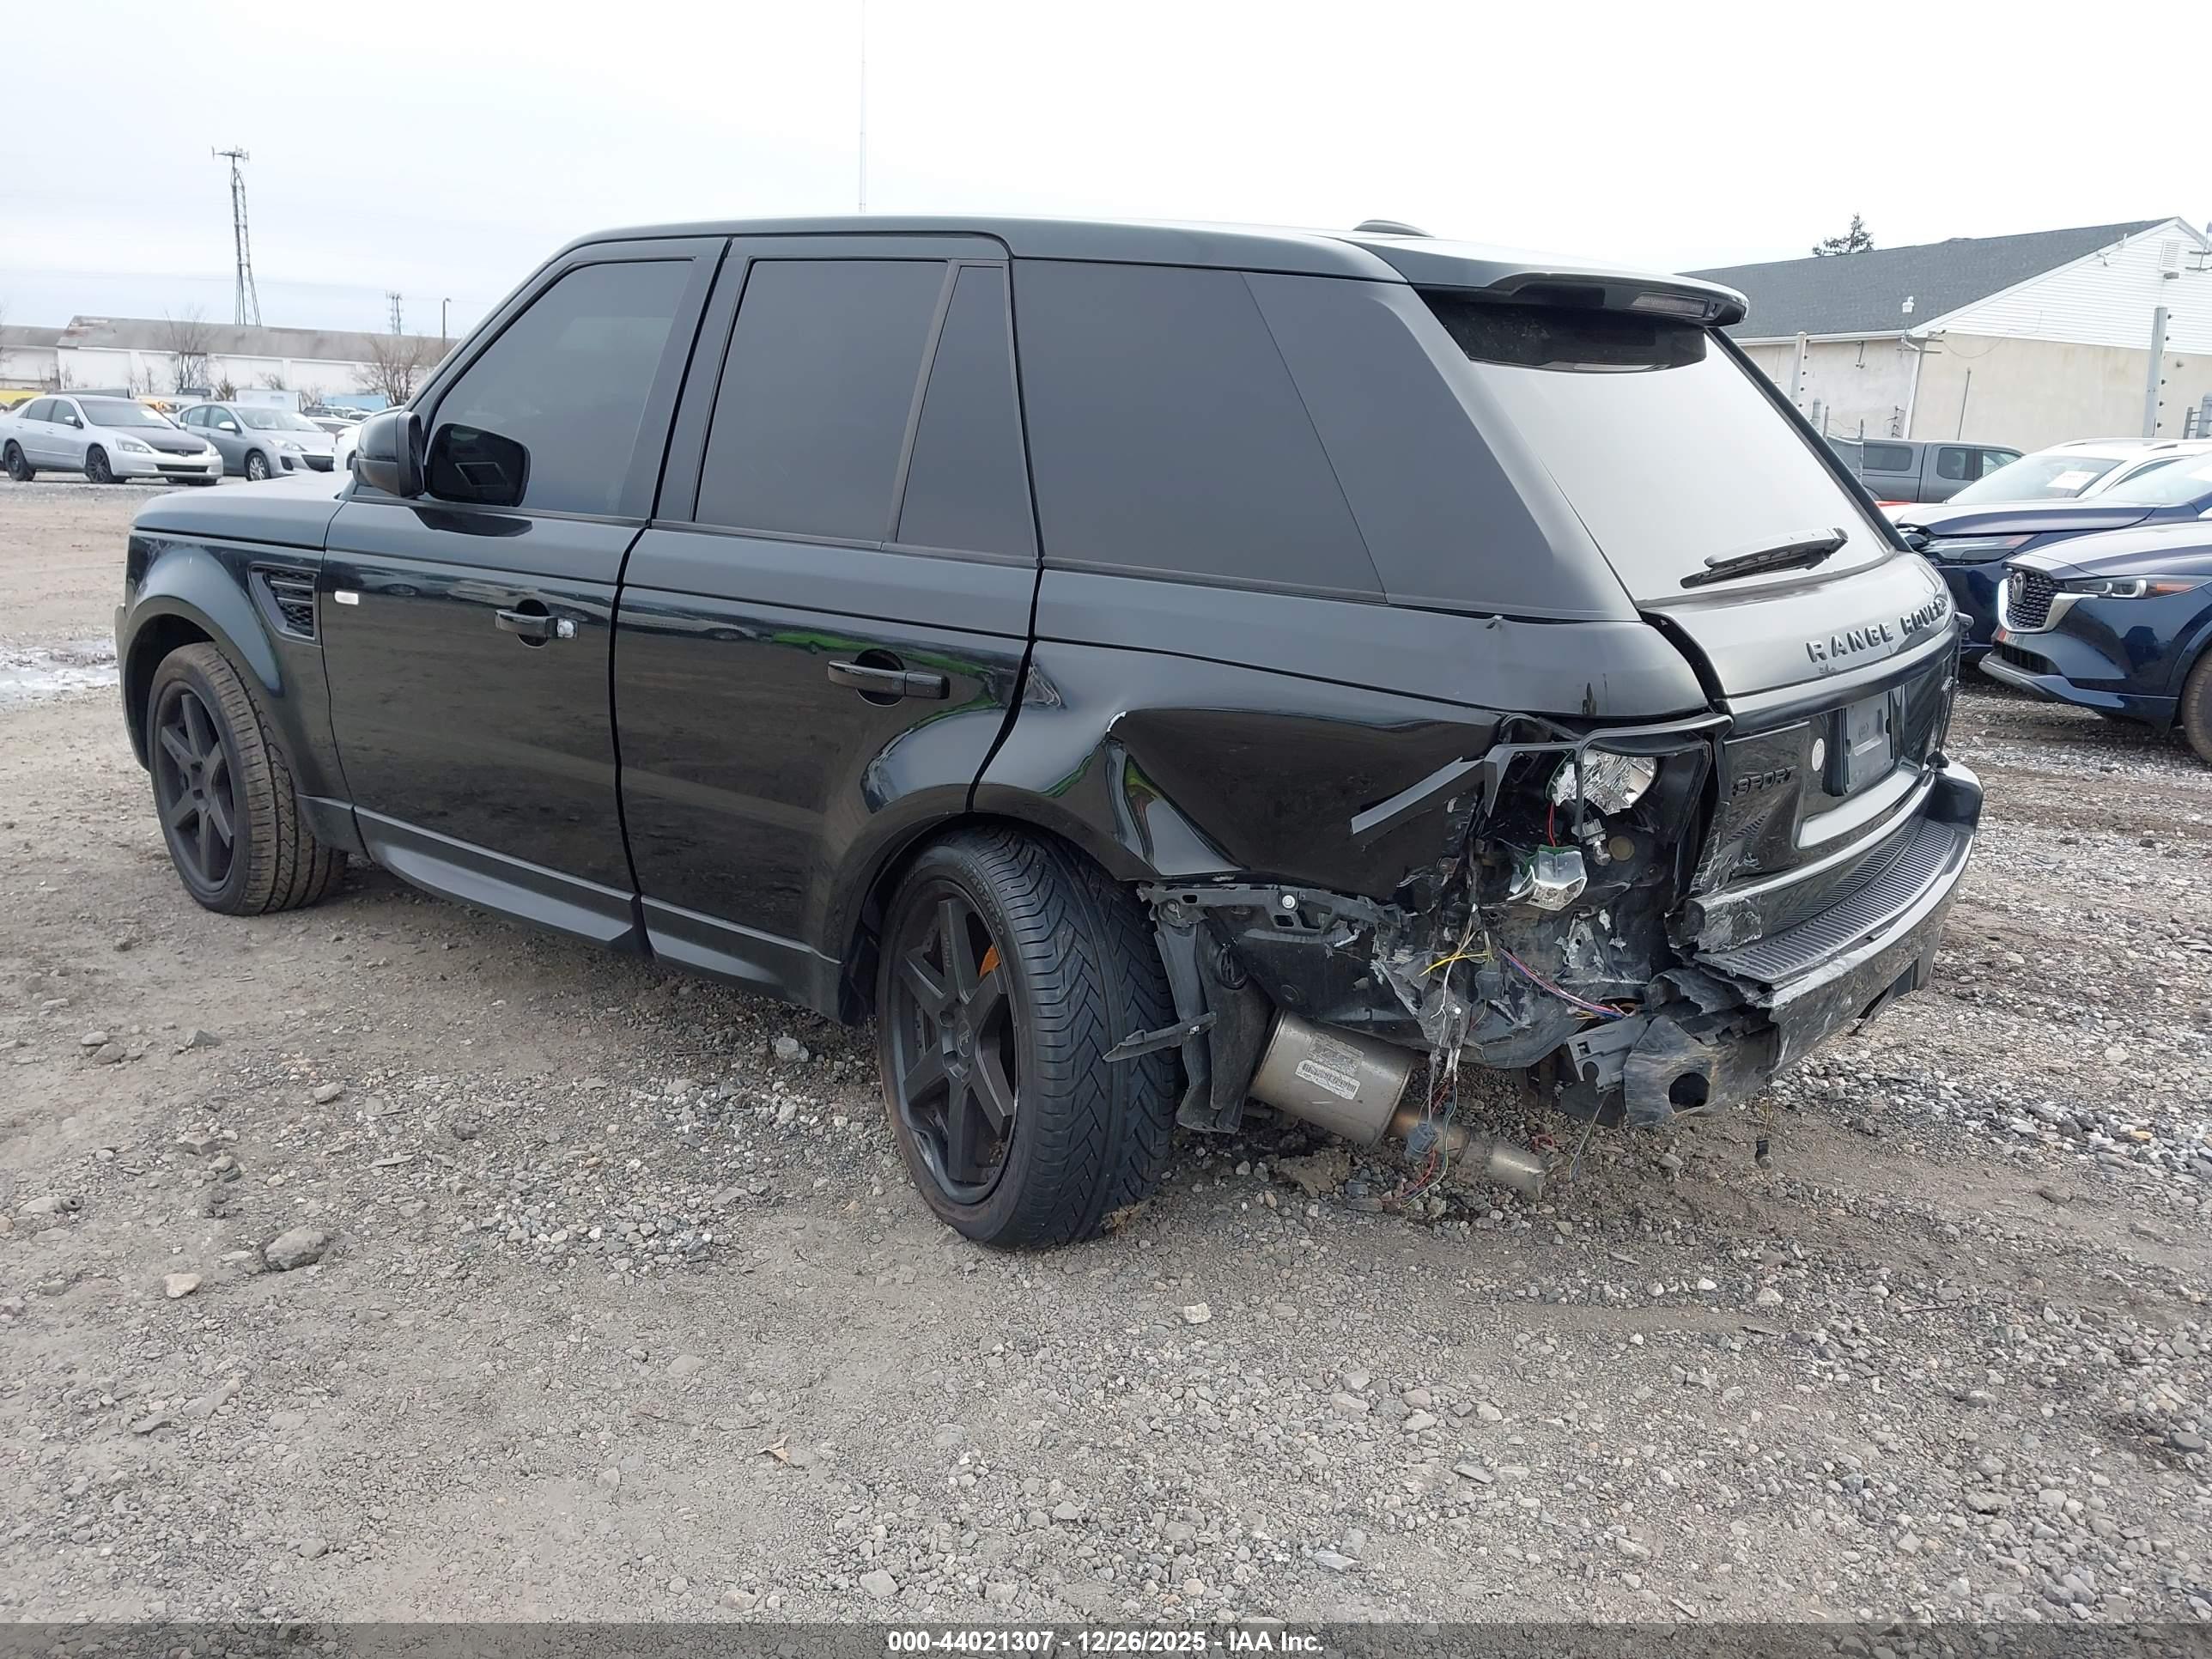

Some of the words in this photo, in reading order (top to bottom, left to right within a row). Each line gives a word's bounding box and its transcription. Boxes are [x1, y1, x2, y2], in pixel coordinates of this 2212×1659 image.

[1805, 623, 1894, 663] RANGE
[1899, 599, 1947, 636] ROVER
[1731, 764, 1798, 797] SPORT
